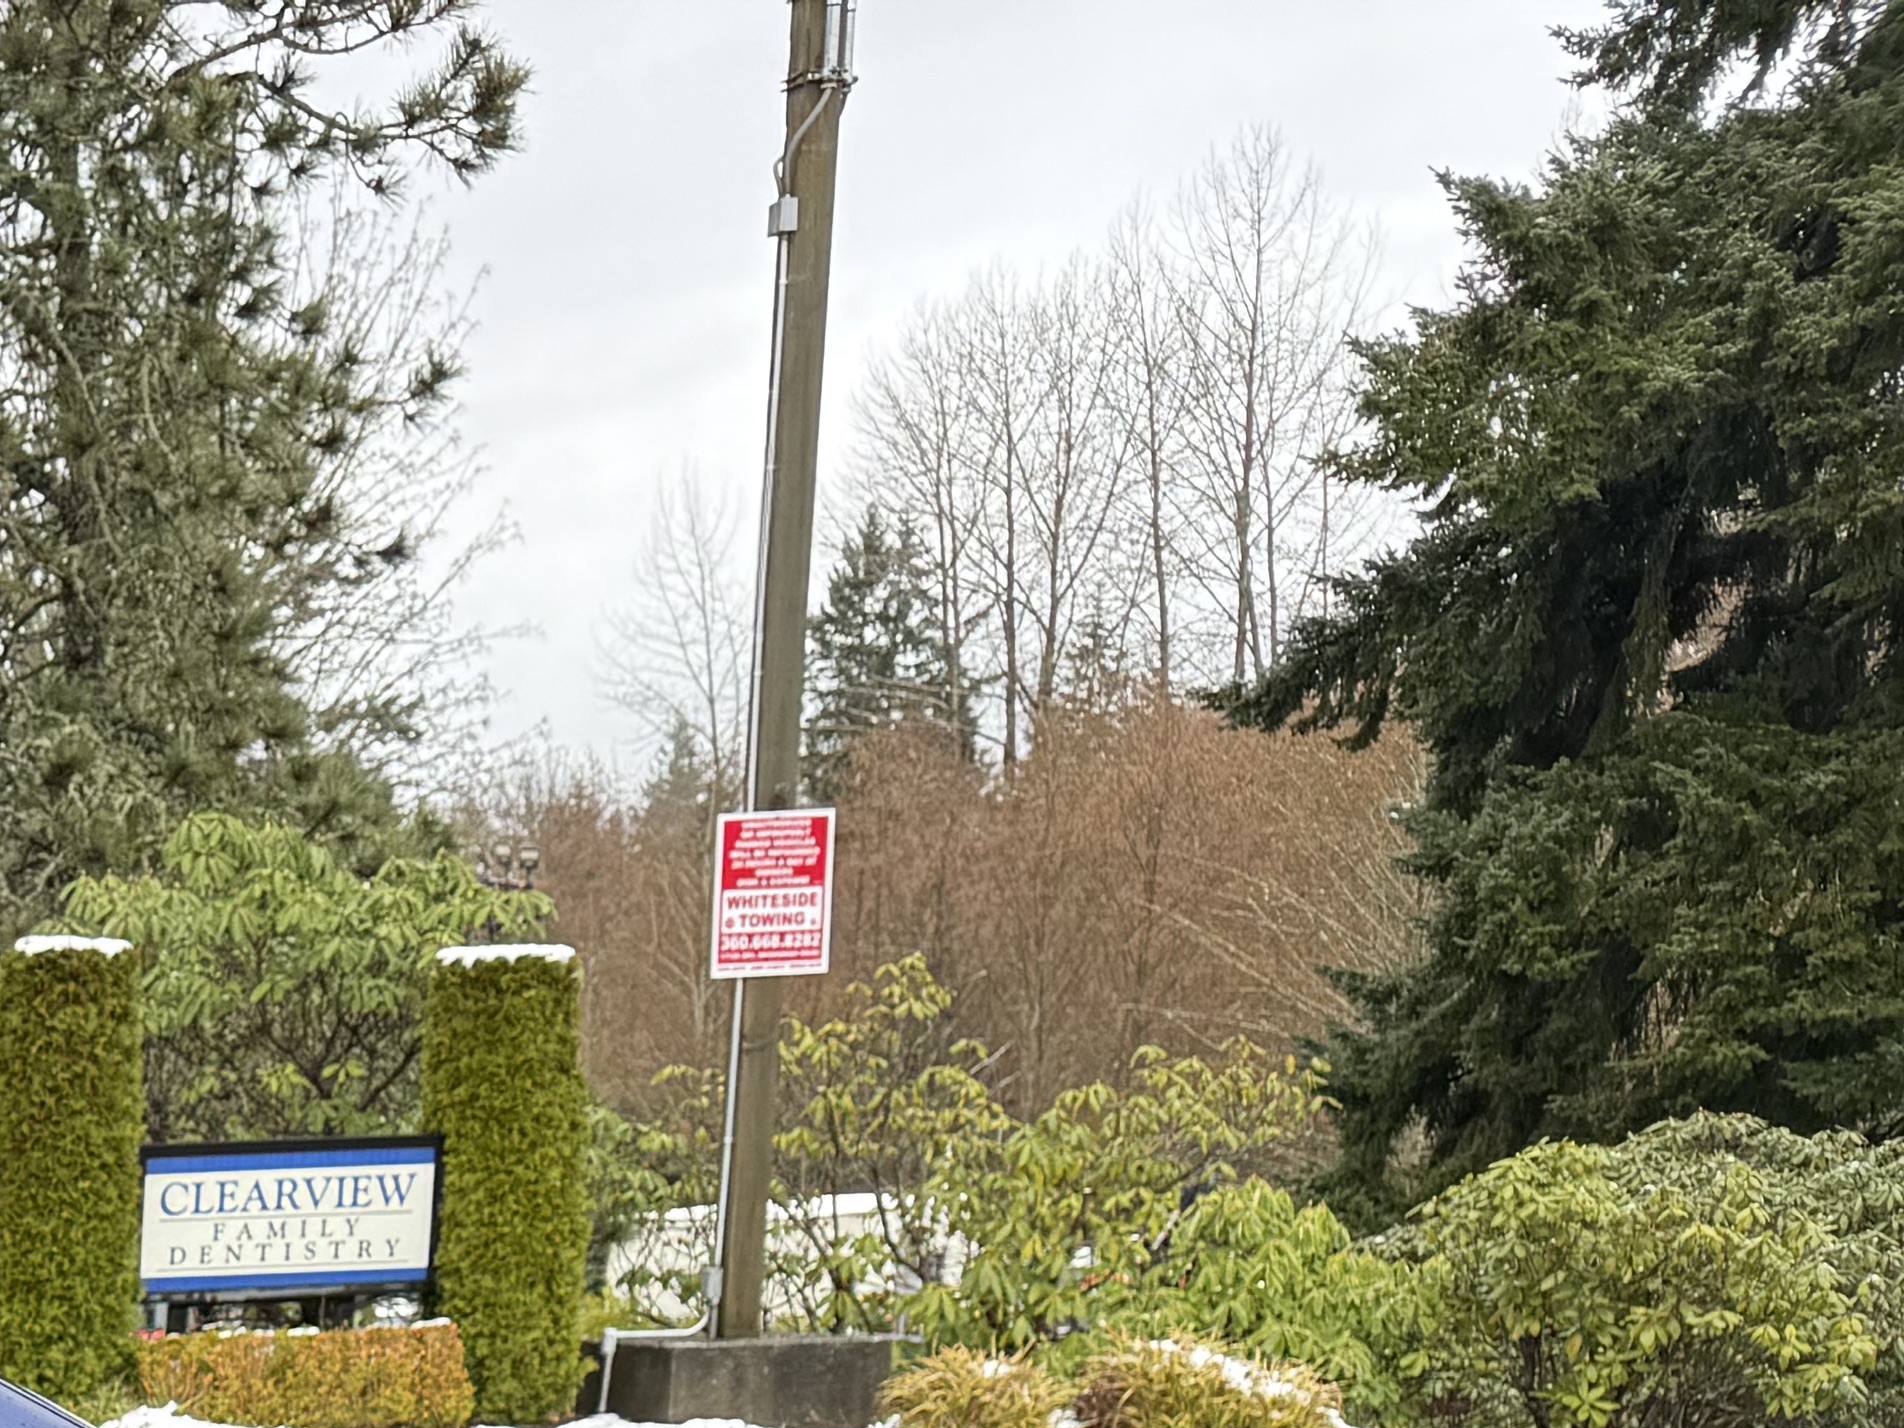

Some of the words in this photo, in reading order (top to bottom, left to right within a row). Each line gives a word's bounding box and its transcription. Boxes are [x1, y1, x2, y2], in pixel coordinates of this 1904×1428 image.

[727, 892, 817, 909] WHITESIDE
[739, 911, 805, 928] TOWING
[160, 1173, 417, 1216] CLEARVIEW
[212, 1217, 360, 1242] FAMILY
[169, 1238, 400, 1266] DENTISTRY
